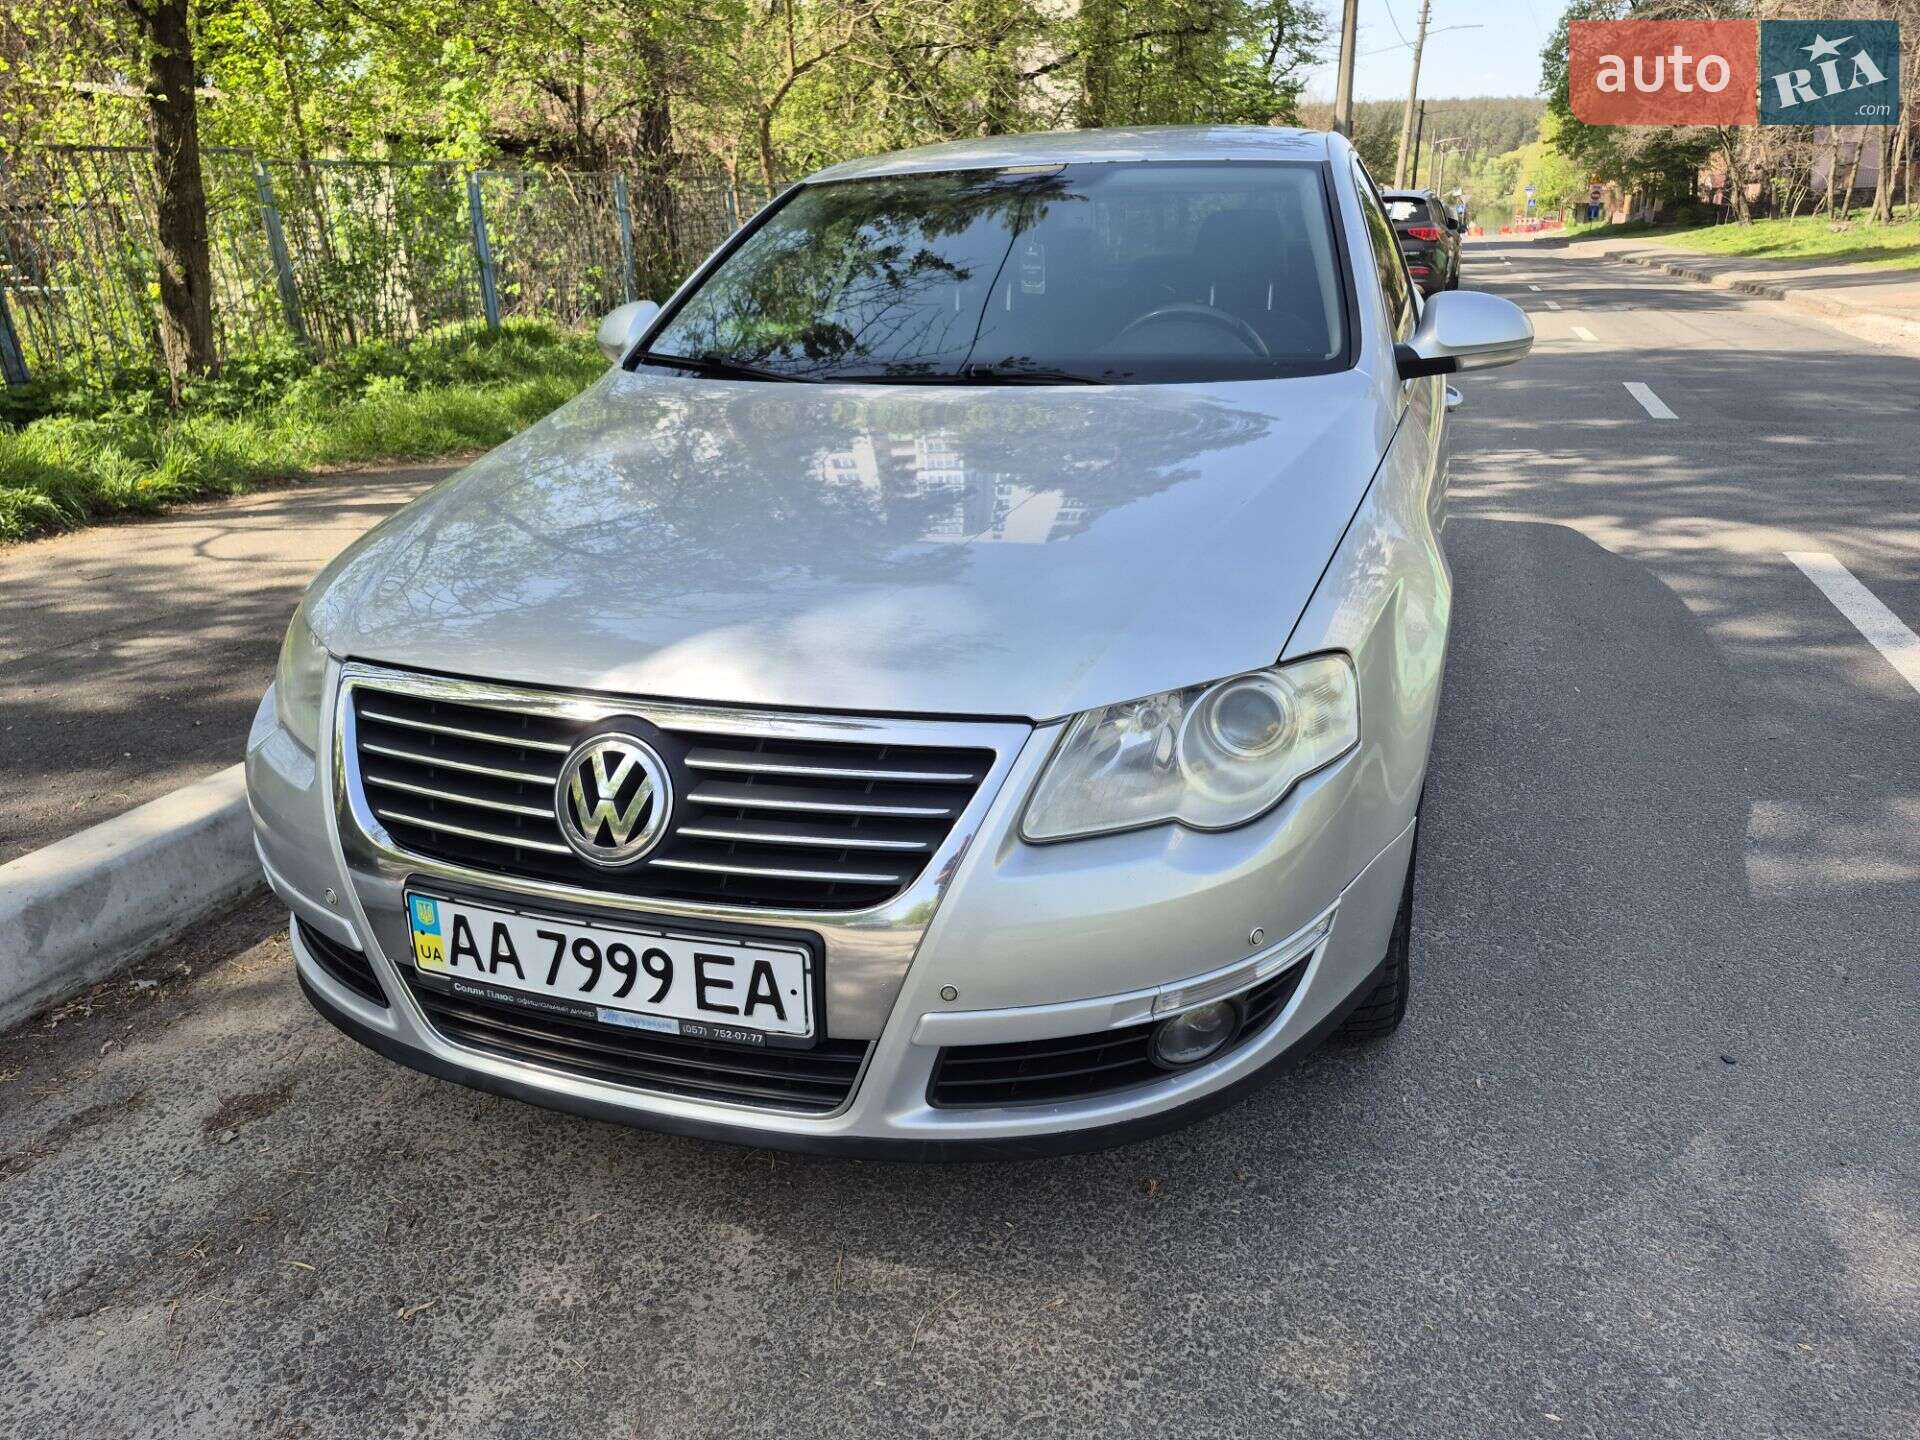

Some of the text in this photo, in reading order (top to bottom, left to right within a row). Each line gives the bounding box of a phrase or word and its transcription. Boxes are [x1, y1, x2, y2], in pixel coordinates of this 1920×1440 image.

[420, 944, 444, 962] UA
[449, 913, 788, 1022] AA 7999 EA
[454, 982, 486, 997] Солли
[486, 989, 514, 1002] Плюс
[682, 1024, 764, 1043] (057) 752-07-77
